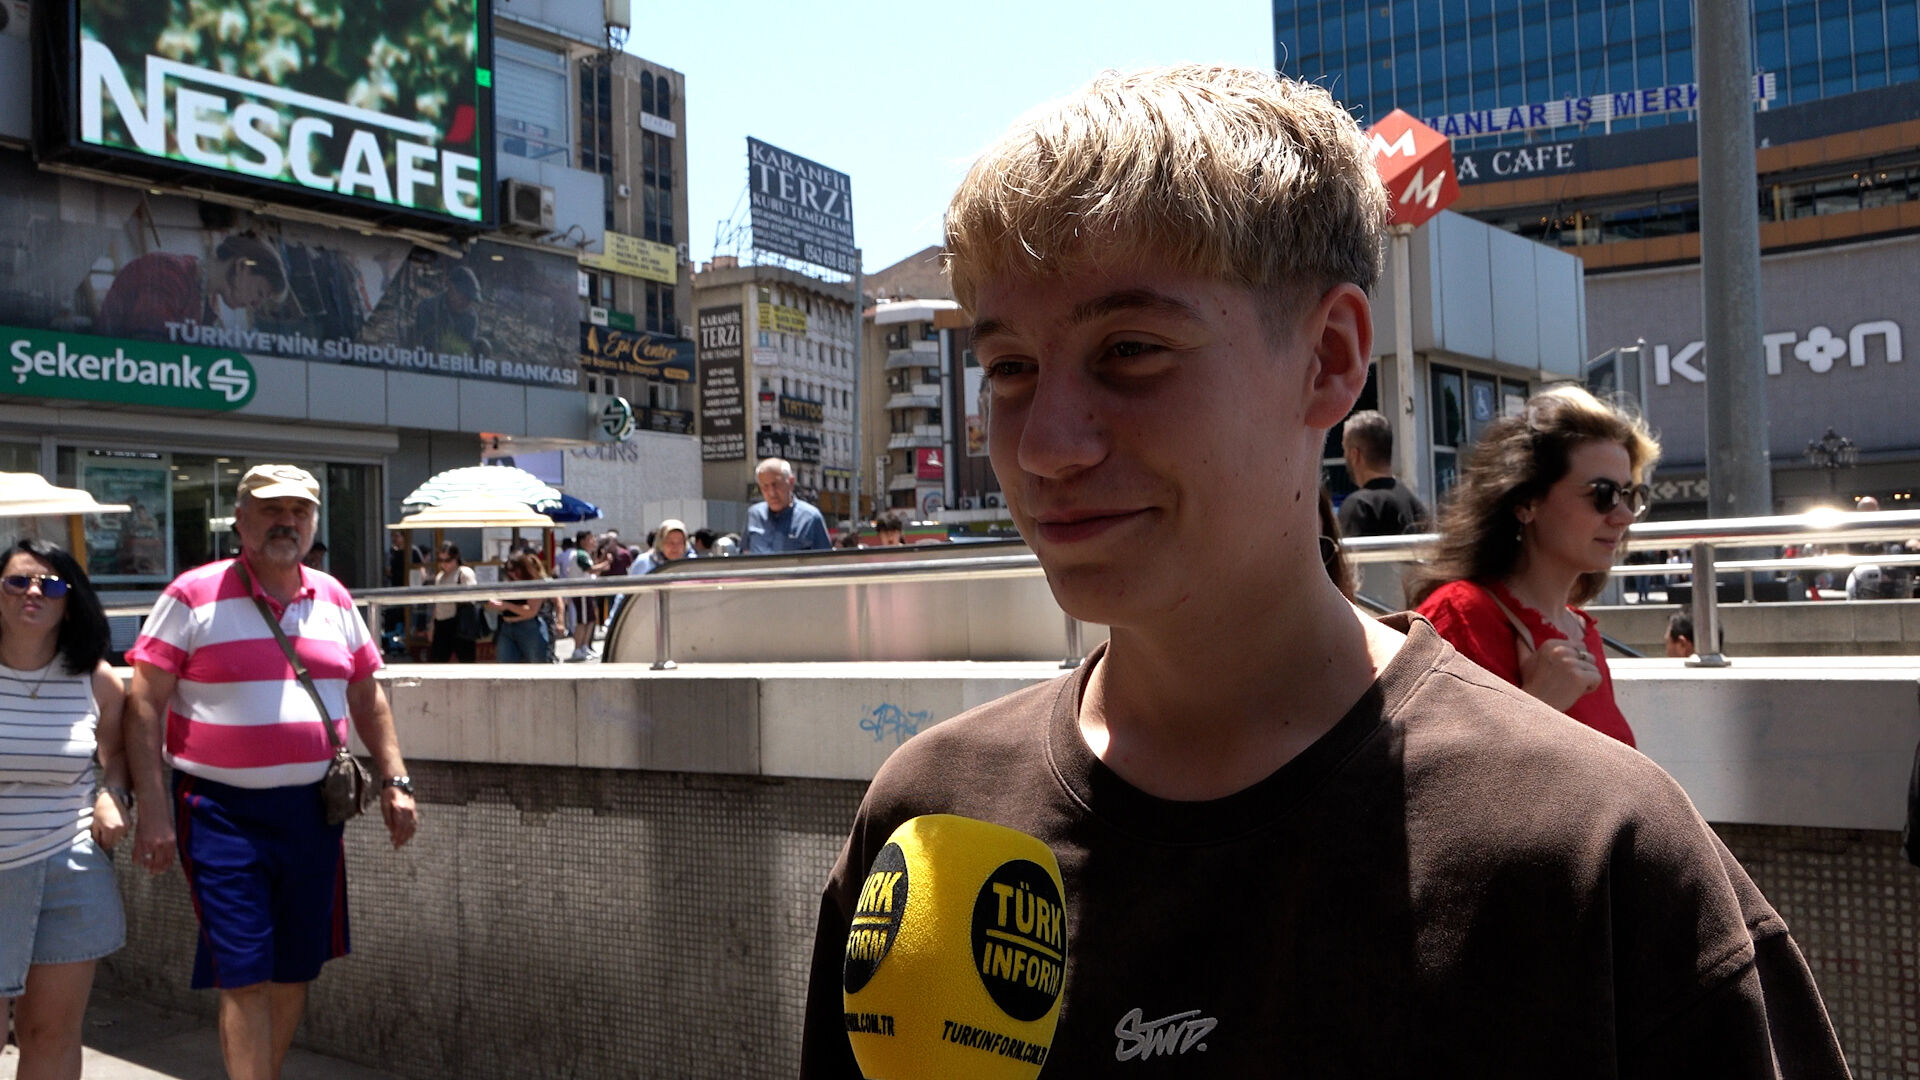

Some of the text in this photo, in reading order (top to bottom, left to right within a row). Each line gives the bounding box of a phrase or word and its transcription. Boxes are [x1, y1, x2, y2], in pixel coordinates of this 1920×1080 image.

[1613, 66, 1764, 117] MERKİ
[1492, 144, 1575, 175] CAFE
[752, 159, 852, 221] TERZİ
[10, 339, 203, 389] Şekerbank
[165, 318, 578, 385] TÜRKİYE'NİN SÜRDÜRÜLEBİLİR BANKASI
[993, 881, 1062, 949] TÜRK
[983, 941, 1060, 997] INFORM
